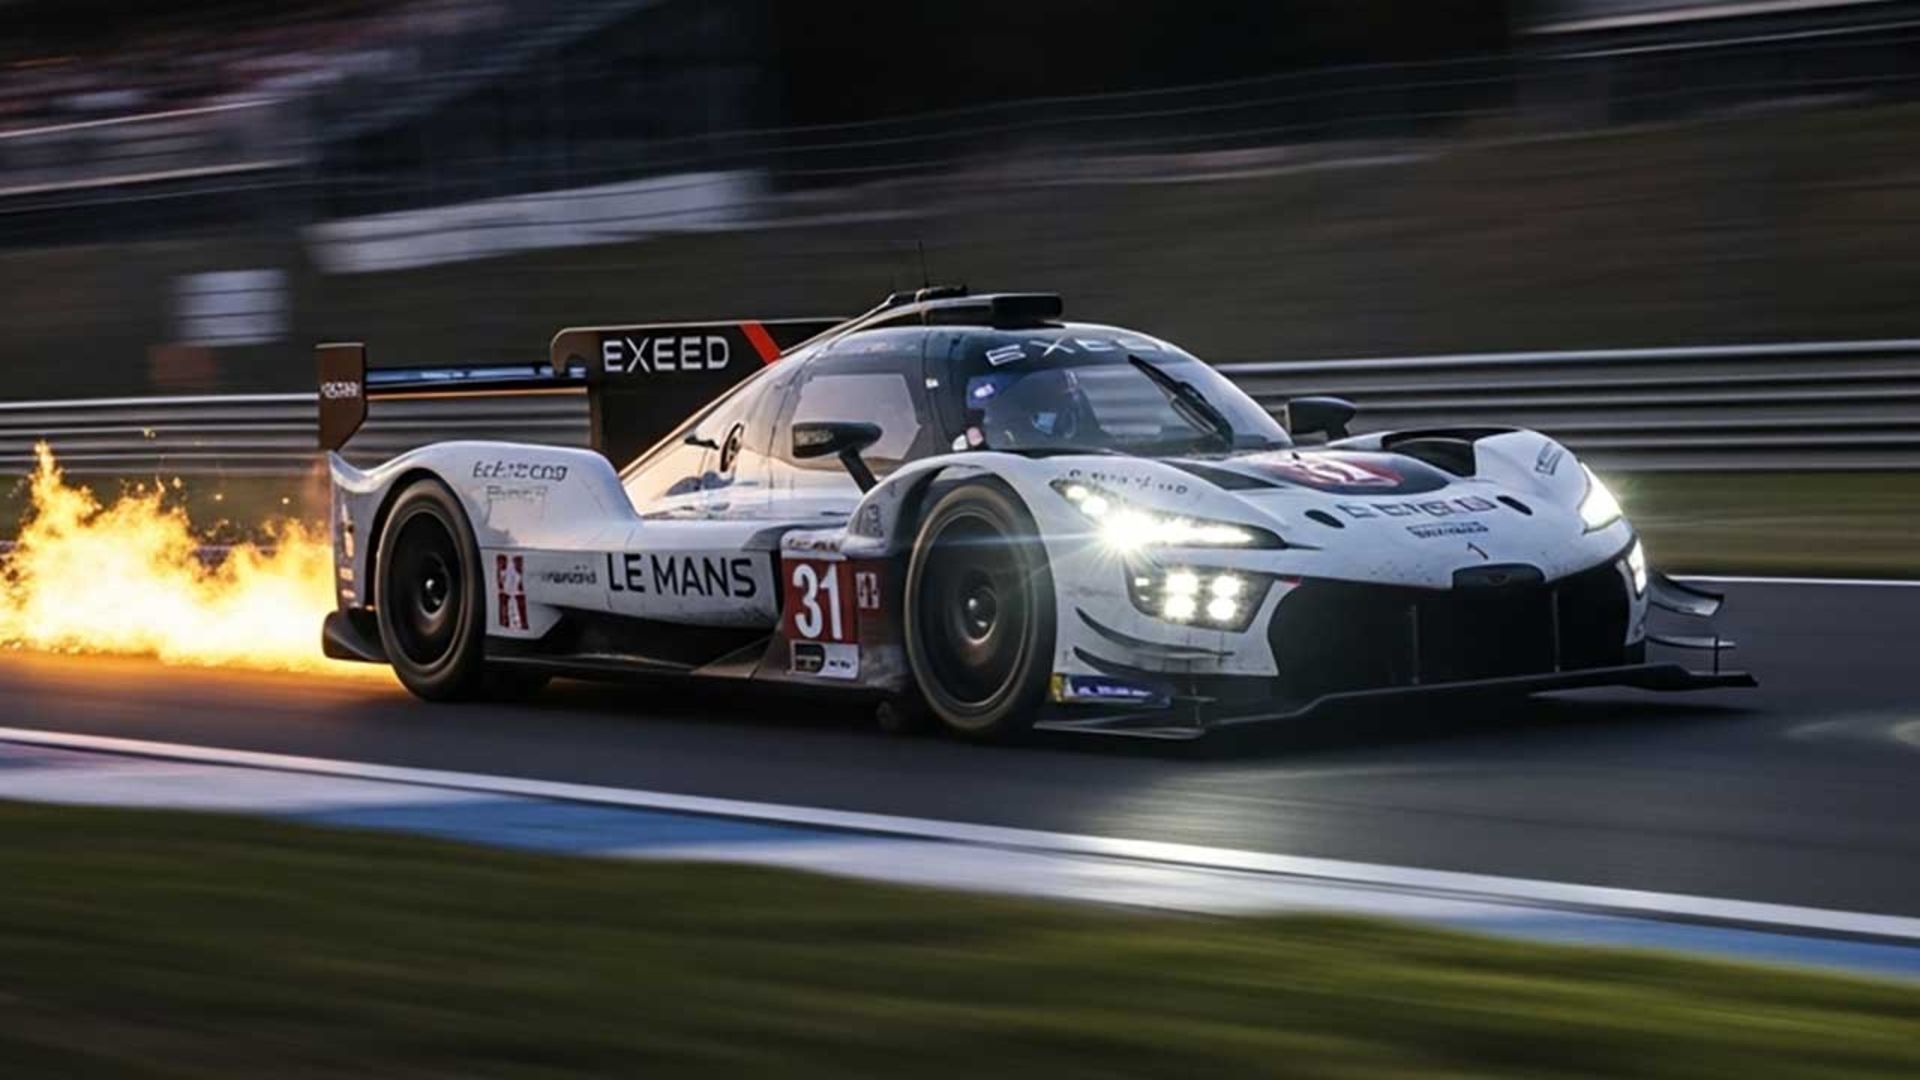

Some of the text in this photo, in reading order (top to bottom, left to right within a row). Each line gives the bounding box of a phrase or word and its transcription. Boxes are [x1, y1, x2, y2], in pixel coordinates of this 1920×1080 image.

[603, 336, 729, 373] EXEED
[607, 553, 645, 592] LE
[651, 554, 756, 598] MANS
[792, 563, 843, 640] 31
